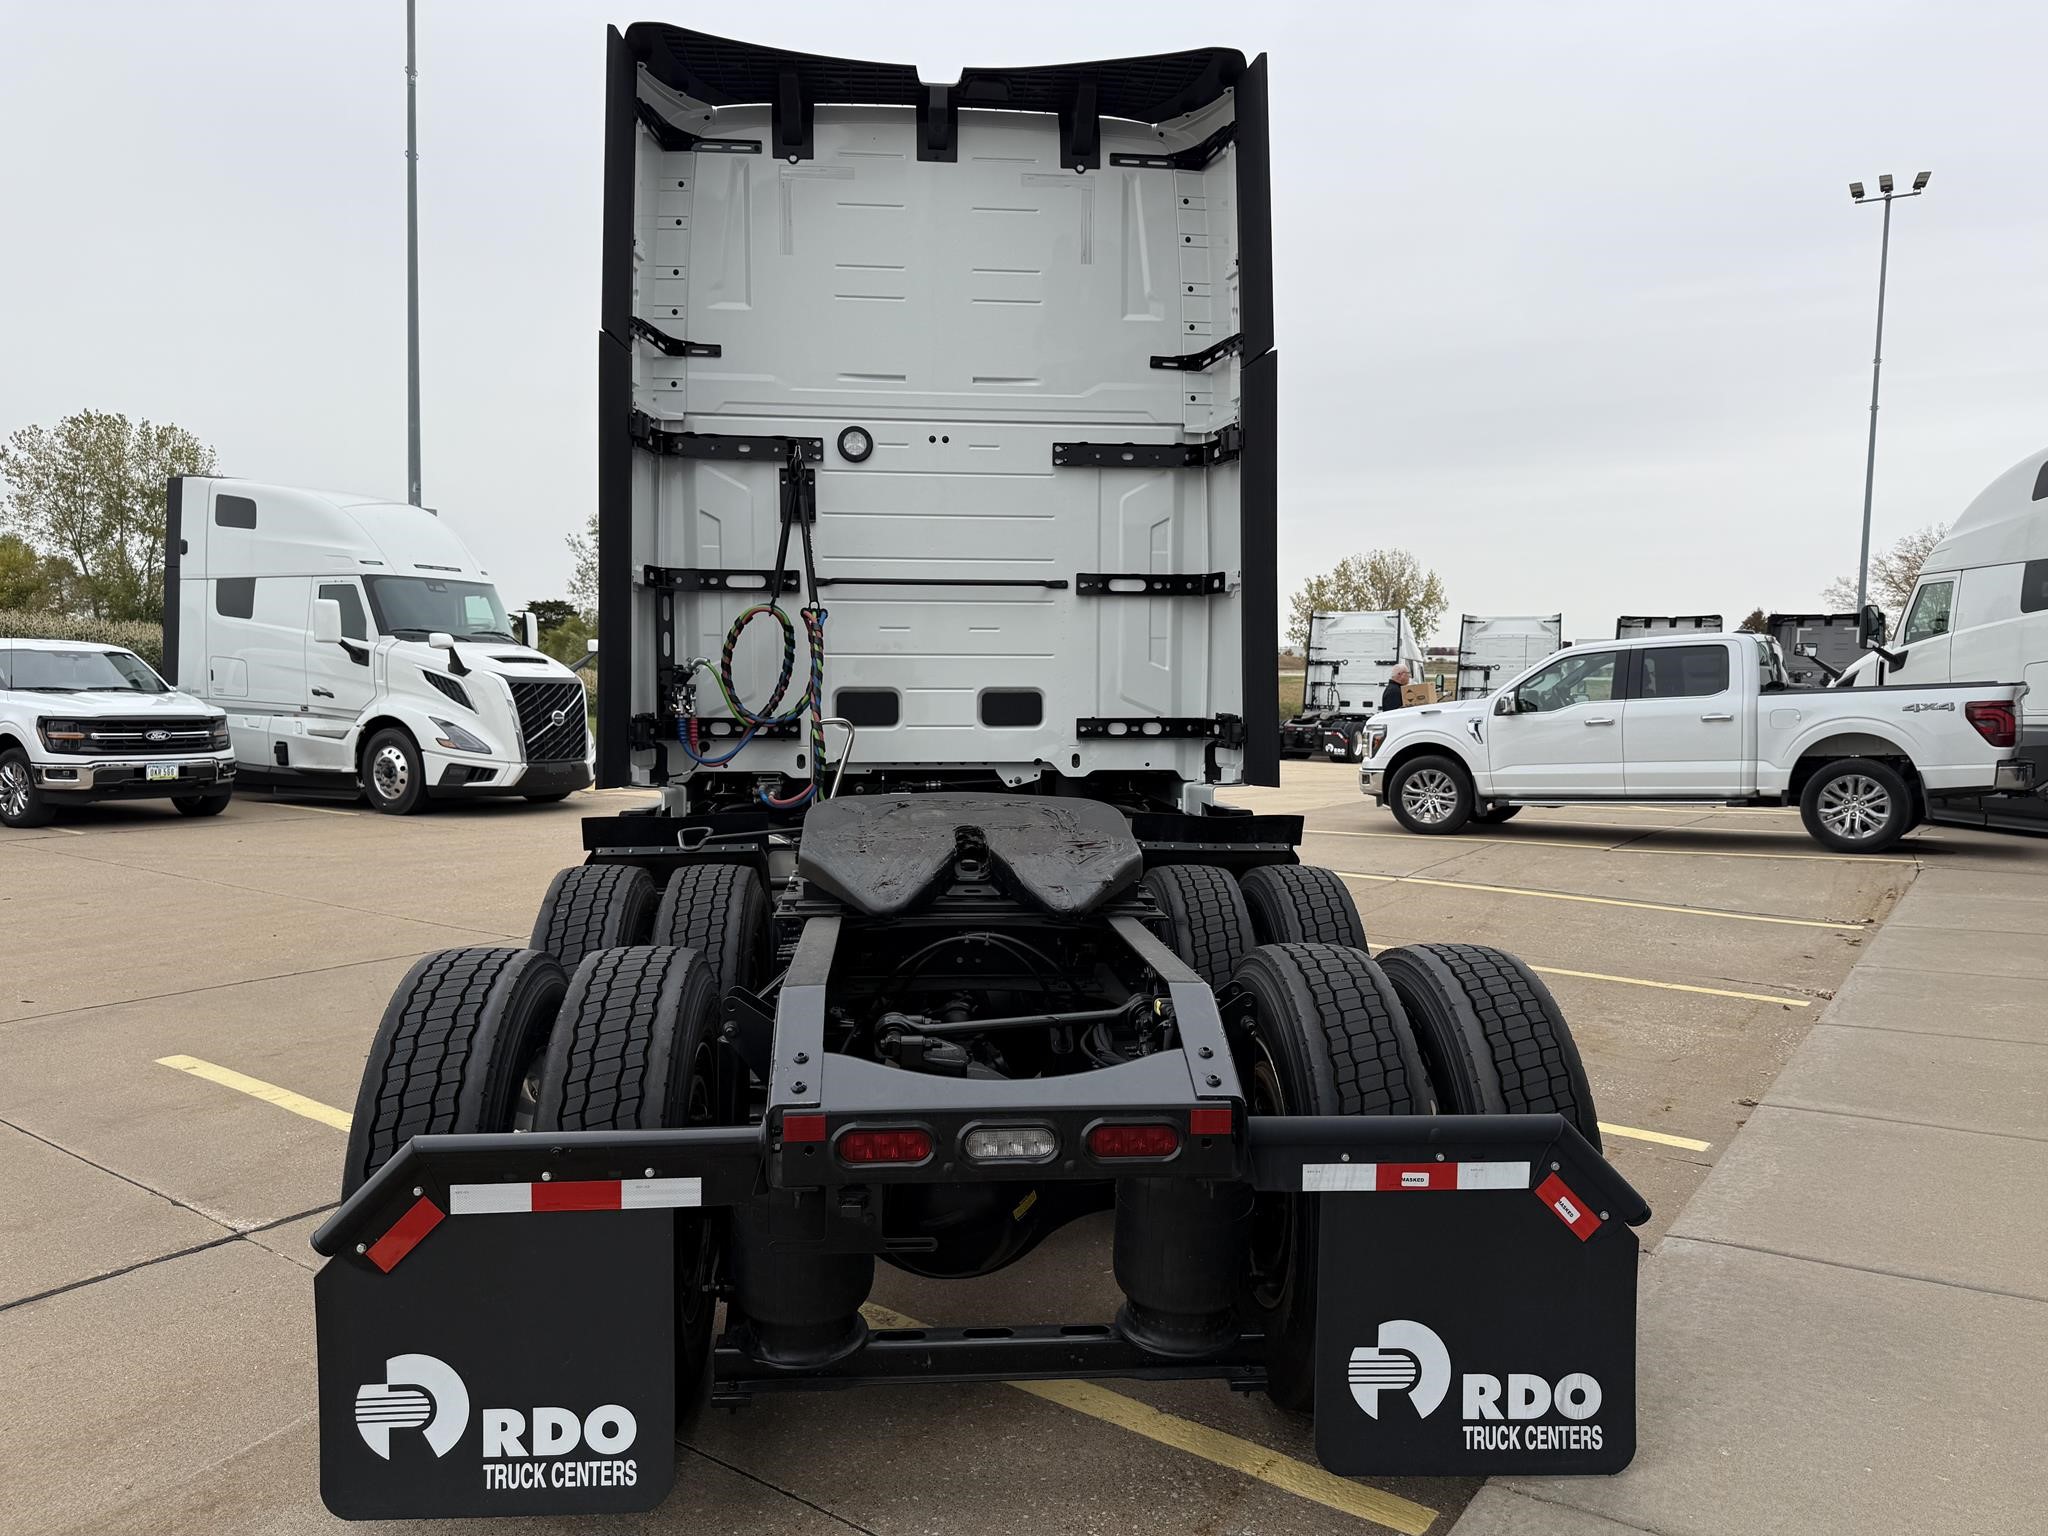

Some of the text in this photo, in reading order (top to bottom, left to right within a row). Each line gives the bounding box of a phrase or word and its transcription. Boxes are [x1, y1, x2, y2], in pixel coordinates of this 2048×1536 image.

[1462, 1372, 1603, 1420] RDO
[482, 1404, 638, 1458] RDO
[1462, 1425, 1603, 1450] TRUCK CENTERS
[482, 1459, 638, 1490] TRUCK CENTERS
